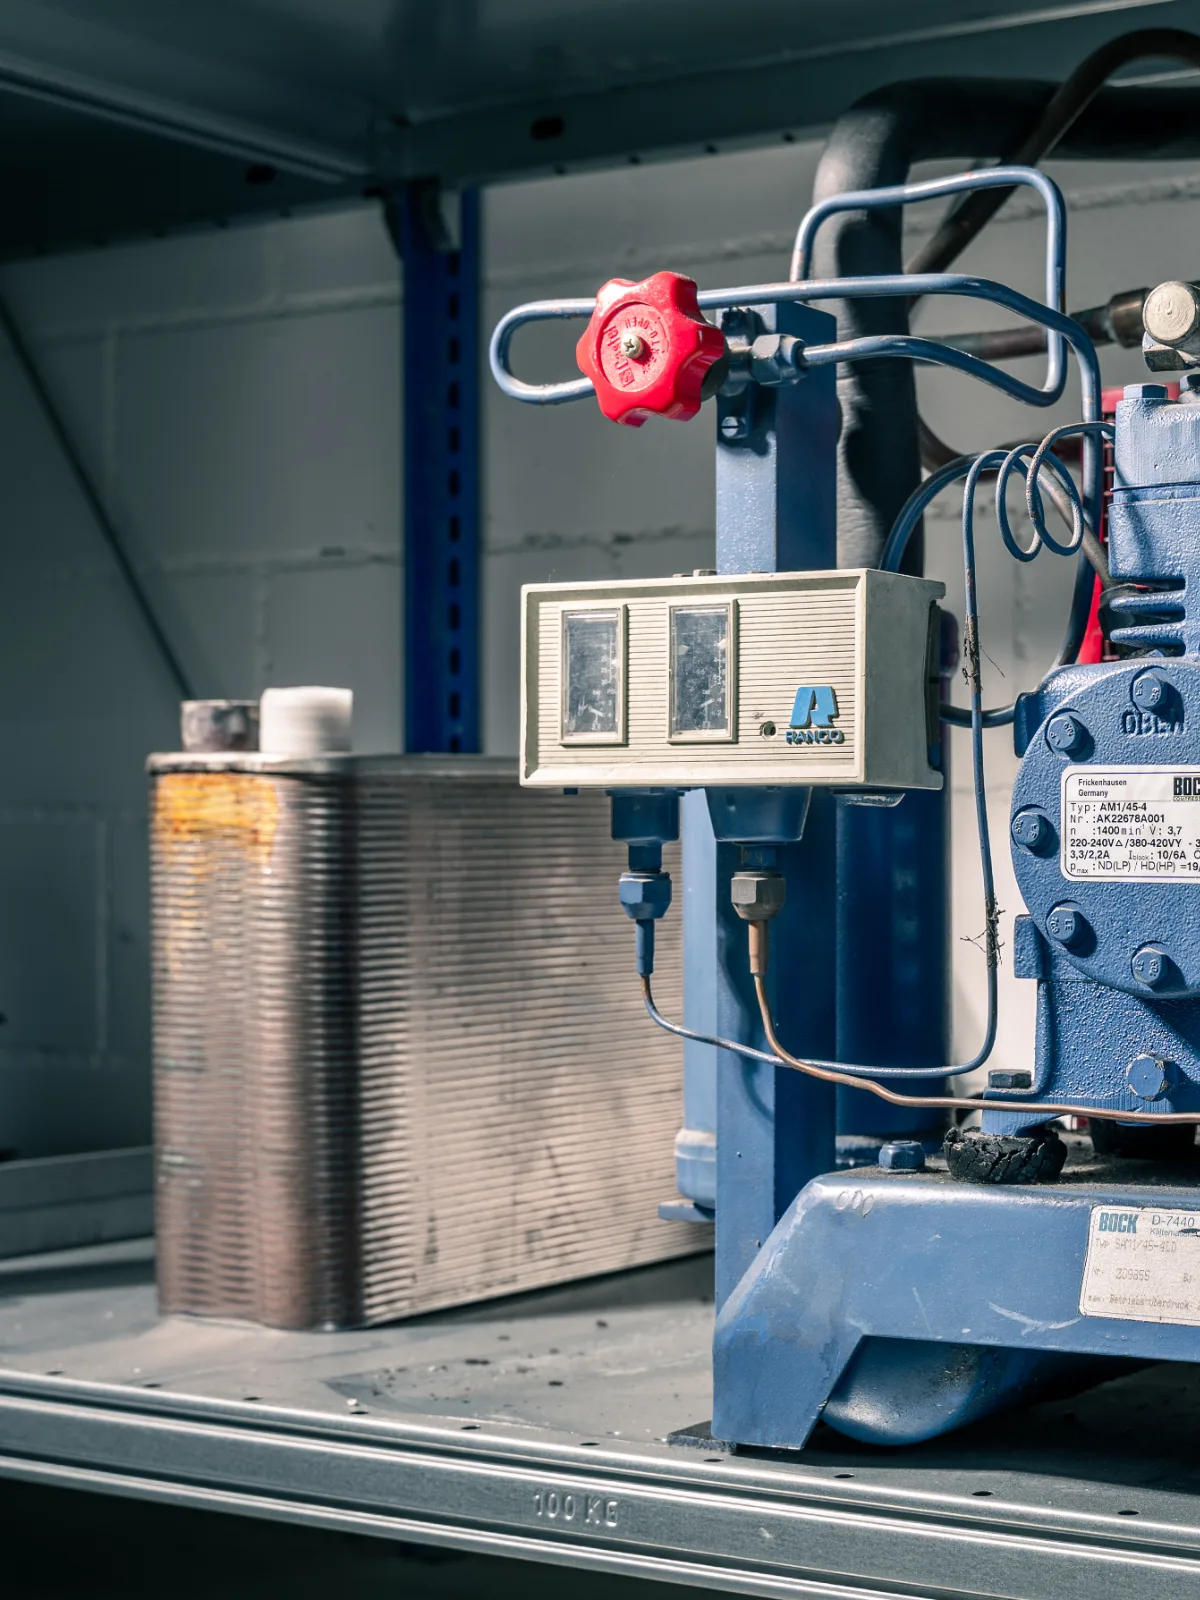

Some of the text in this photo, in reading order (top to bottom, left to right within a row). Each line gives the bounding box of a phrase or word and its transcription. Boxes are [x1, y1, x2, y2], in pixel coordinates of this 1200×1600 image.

[785, 729, 845, 745] RANCO
[1078, 778, 1127, 786] Frickenhausen
[1078, 789, 1108, 798] Germany
[1099, 802, 1147, 812] AM1/45-4
[1167, 826, 1182, 837] 3,7
[1070, 849, 1110, 860] 3,3/2,2A
[1157, 850, 1186, 860] 10/6A
[1098, 1212, 1140, 1233] BOCK
[1151, 1214, 1195, 1227] D-7440
[534, 1488, 576, 1521] 100
